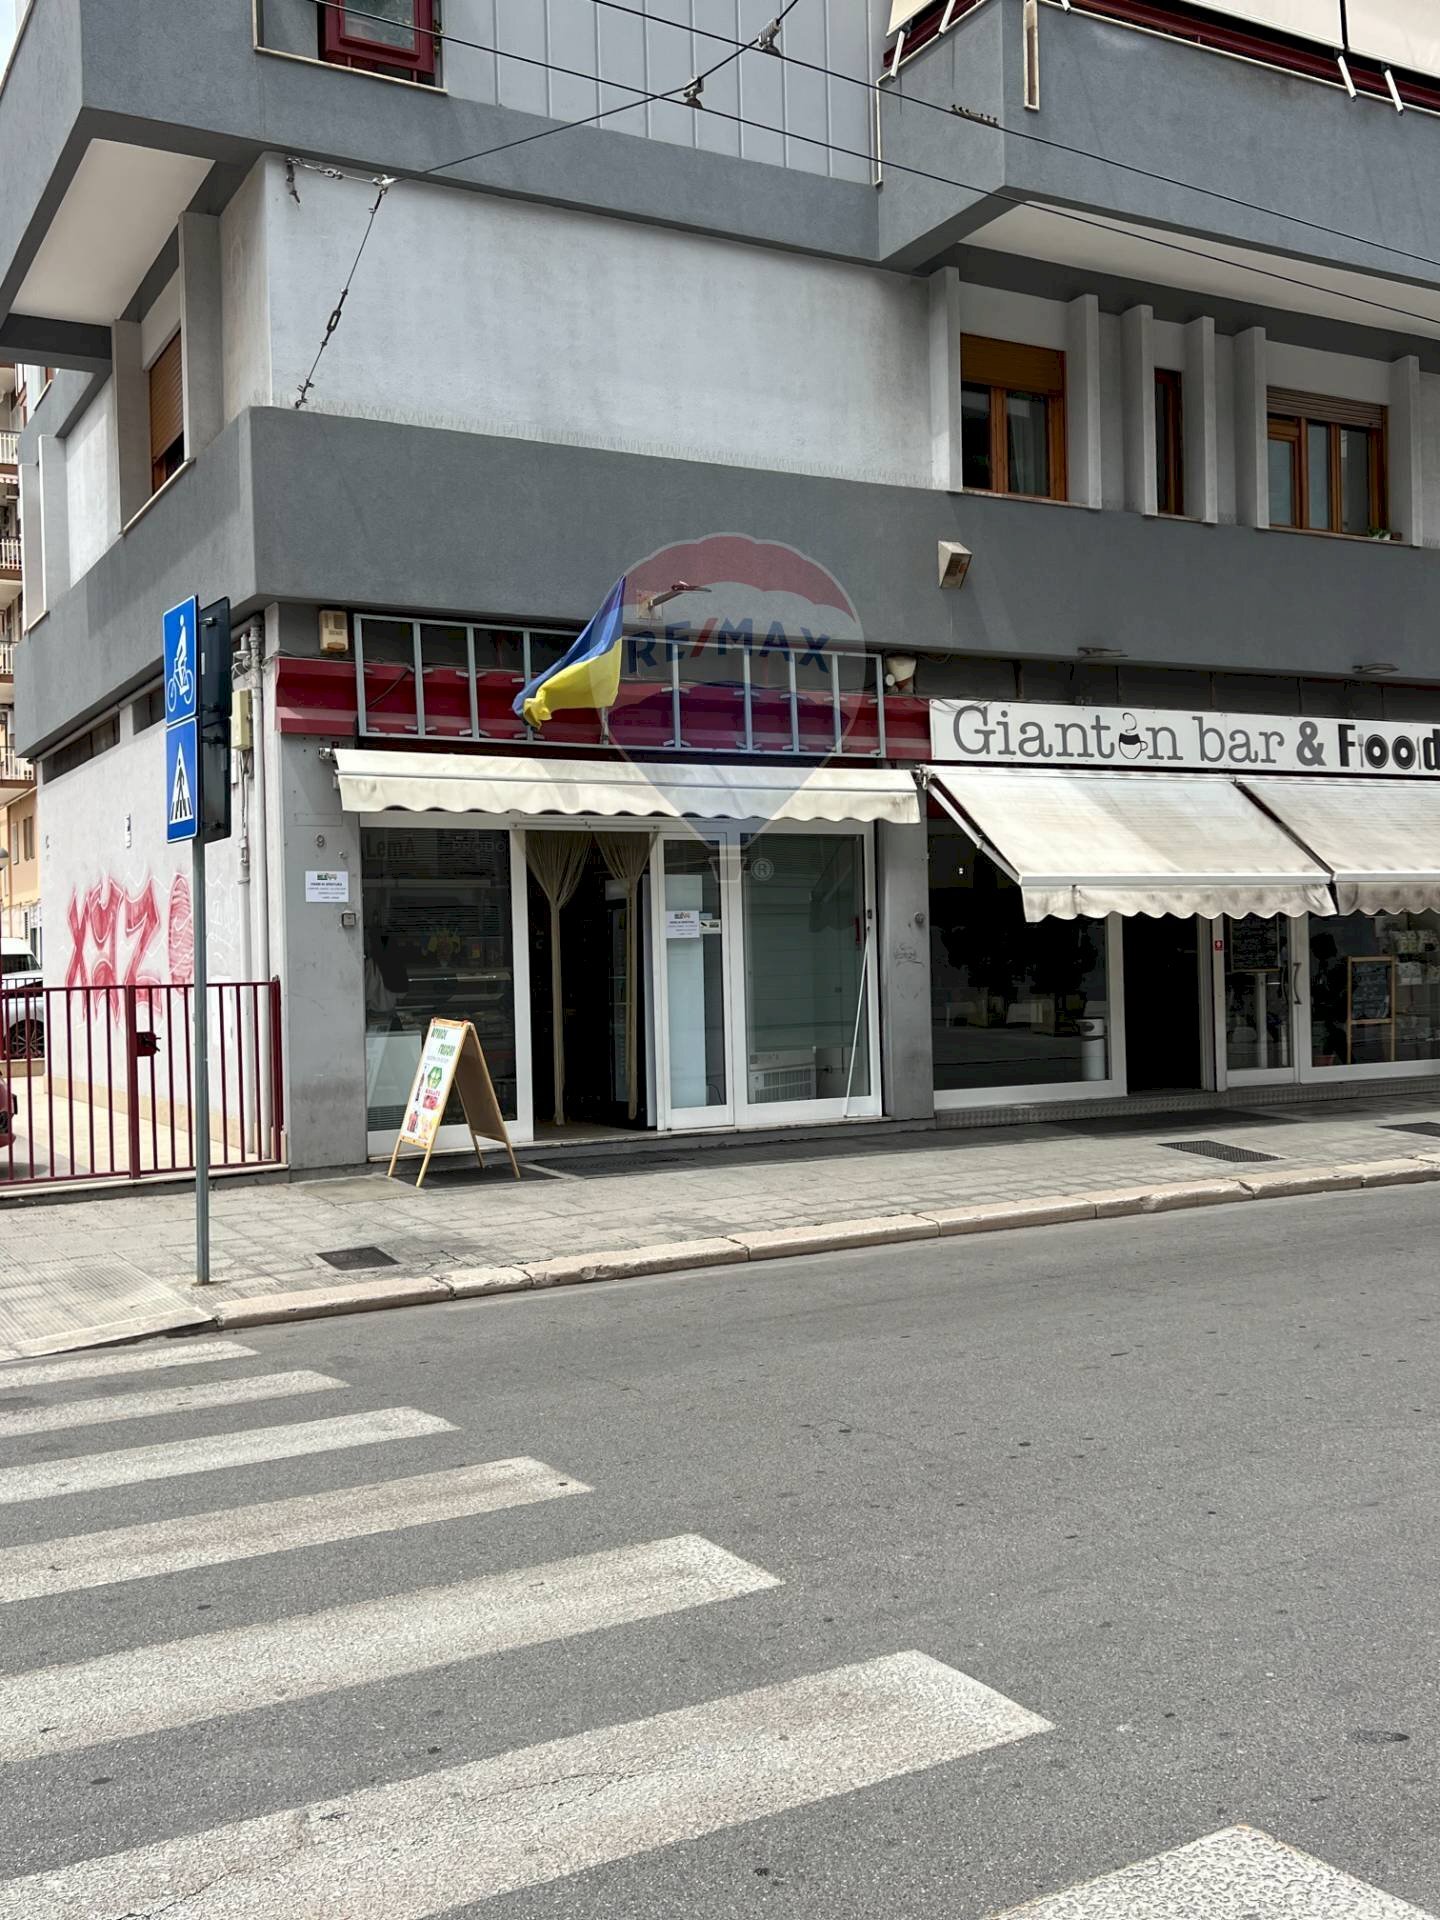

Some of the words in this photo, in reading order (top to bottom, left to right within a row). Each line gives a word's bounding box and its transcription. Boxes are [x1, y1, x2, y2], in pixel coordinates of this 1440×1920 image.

[1192, 715, 1284, 765] bar
[1295, 720, 1327, 767] &
[1337, 723, 1440, 772] Food
[316, 834, 325, 848] 9
